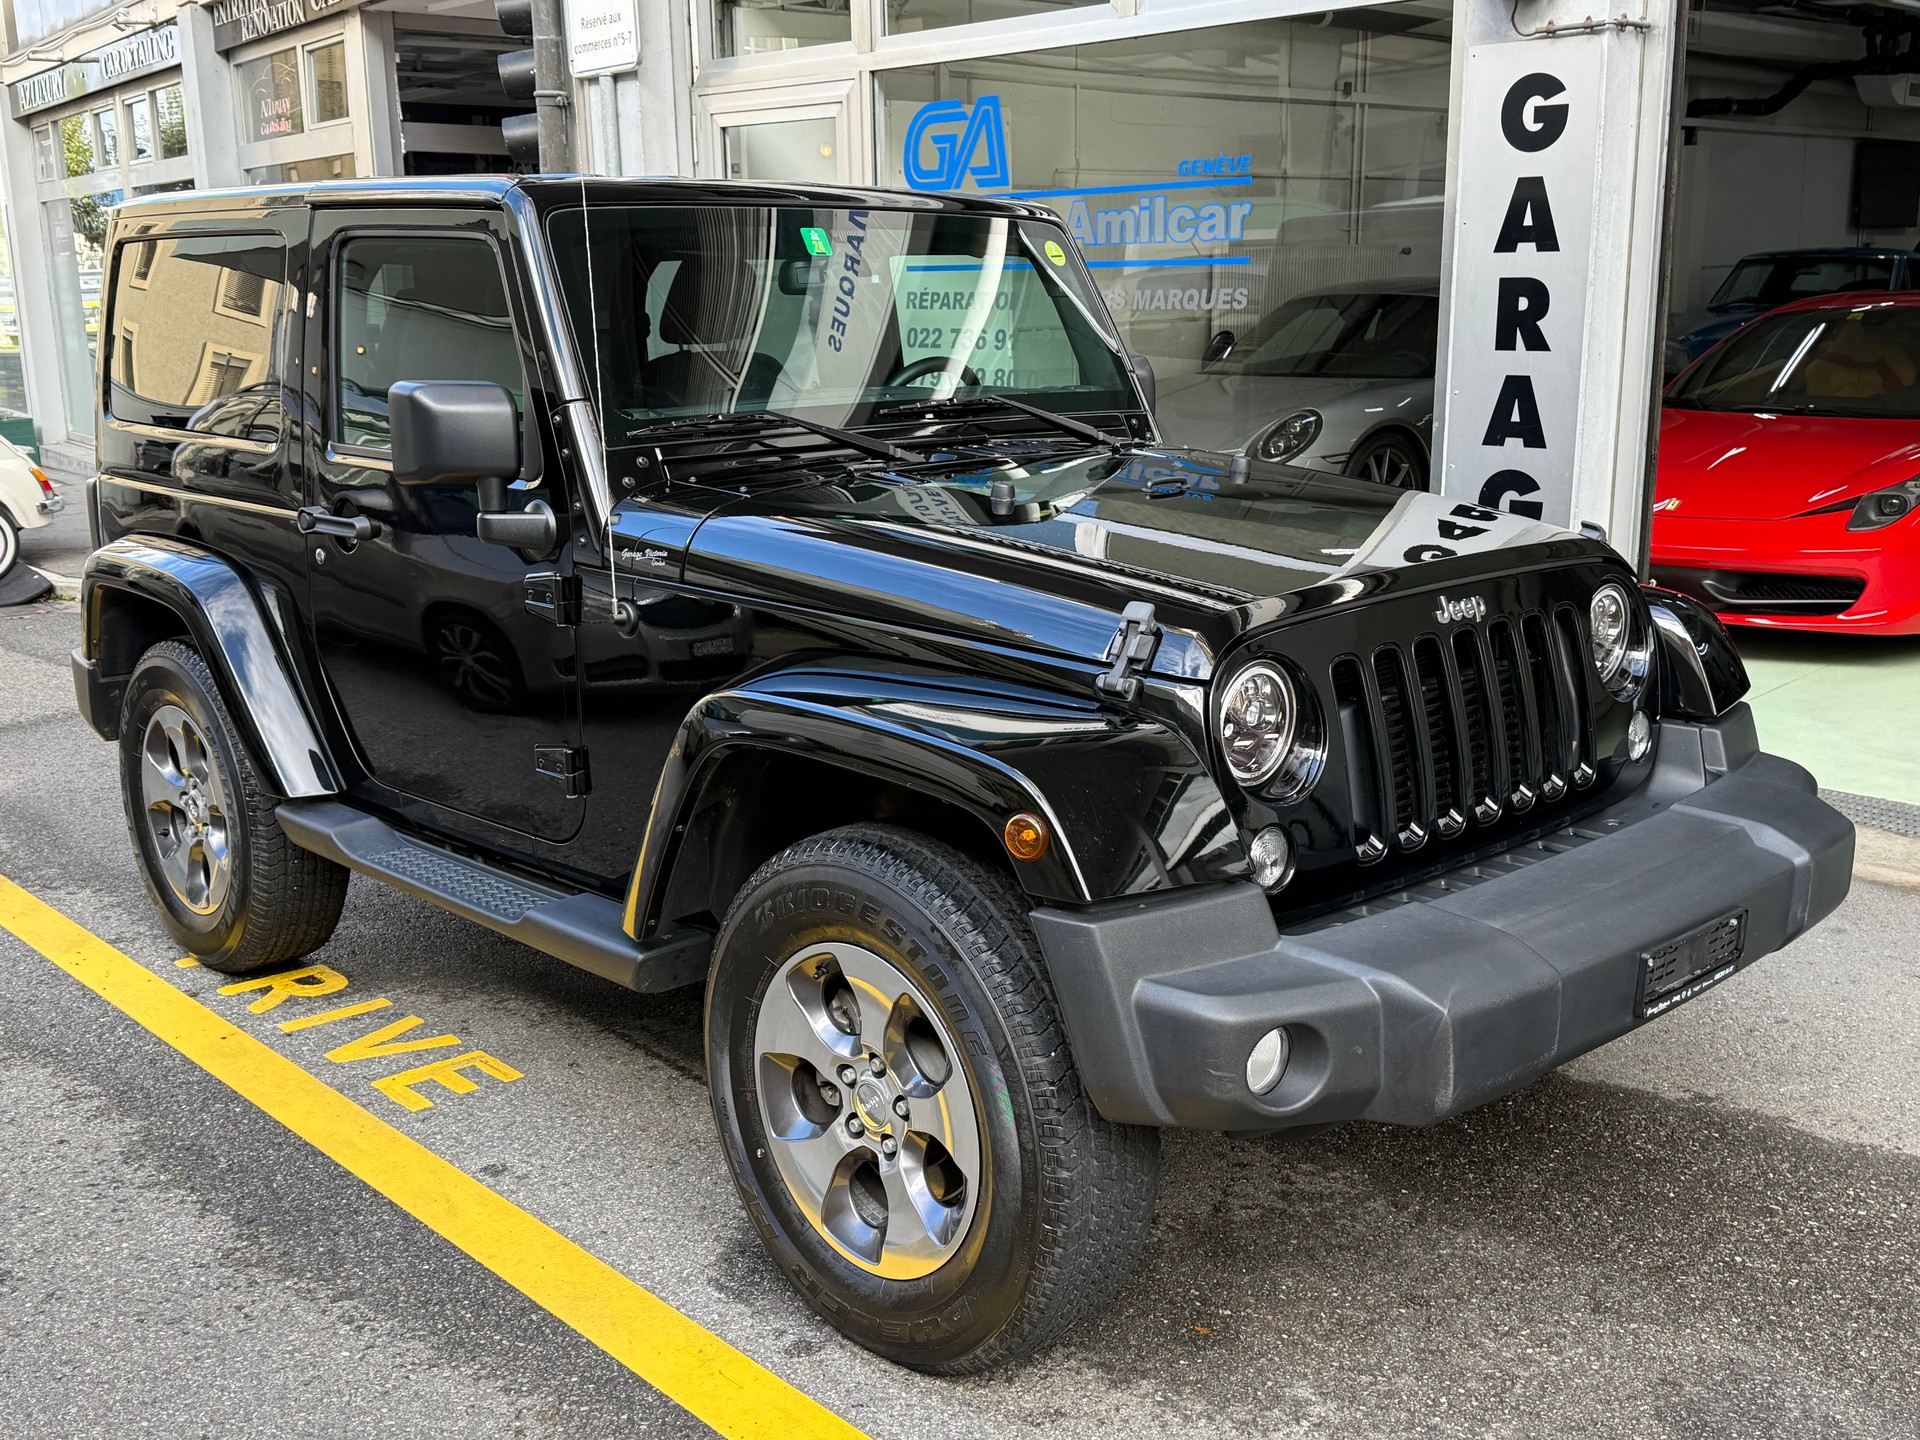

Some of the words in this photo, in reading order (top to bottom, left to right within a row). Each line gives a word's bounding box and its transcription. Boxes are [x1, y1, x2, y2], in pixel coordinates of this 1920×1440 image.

[581, 12, 607, 30] Réservé
[608, 12, 621, 24] aux
[575, 38, 612, 55] commerces
[1177, 153, 1252, 177] GENÈVE
[1067, 194, 1253, 247] Amilcar
[1132, 287, 1249, 311] MARQUES
[1478, 72, 1569, 521] GARAG
[906, 327, 943, 349] 022
[1433, 595, 1486, 624] Jeep
[174, 953, 524, 1112] RIVE
